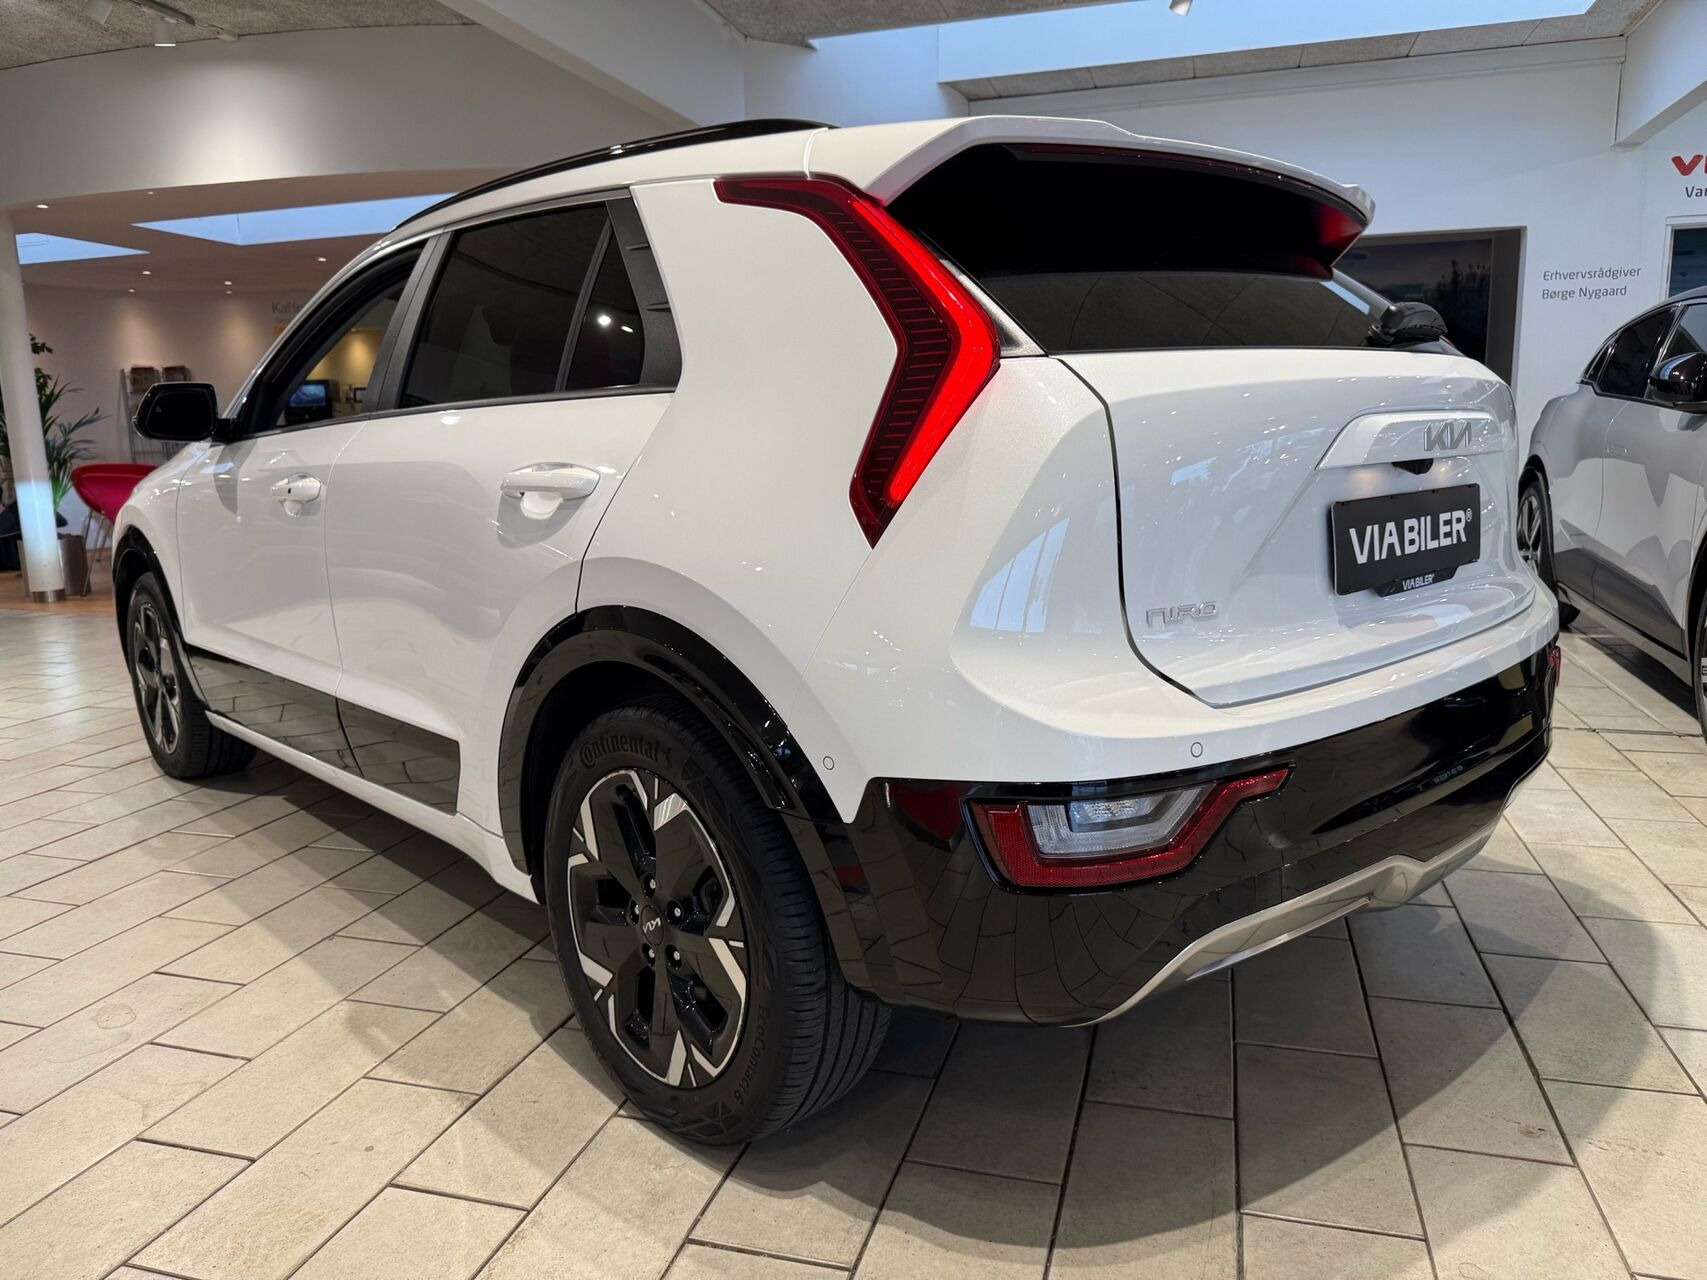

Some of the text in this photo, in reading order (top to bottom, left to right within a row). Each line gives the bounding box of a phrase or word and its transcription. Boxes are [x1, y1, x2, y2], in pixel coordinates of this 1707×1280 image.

[1543, 267, 1641, 281] Erhvervsrådgiver
[1542, 286, 1627, 301] Børge Nygaard
[579, 734, 660, 768] Continental
